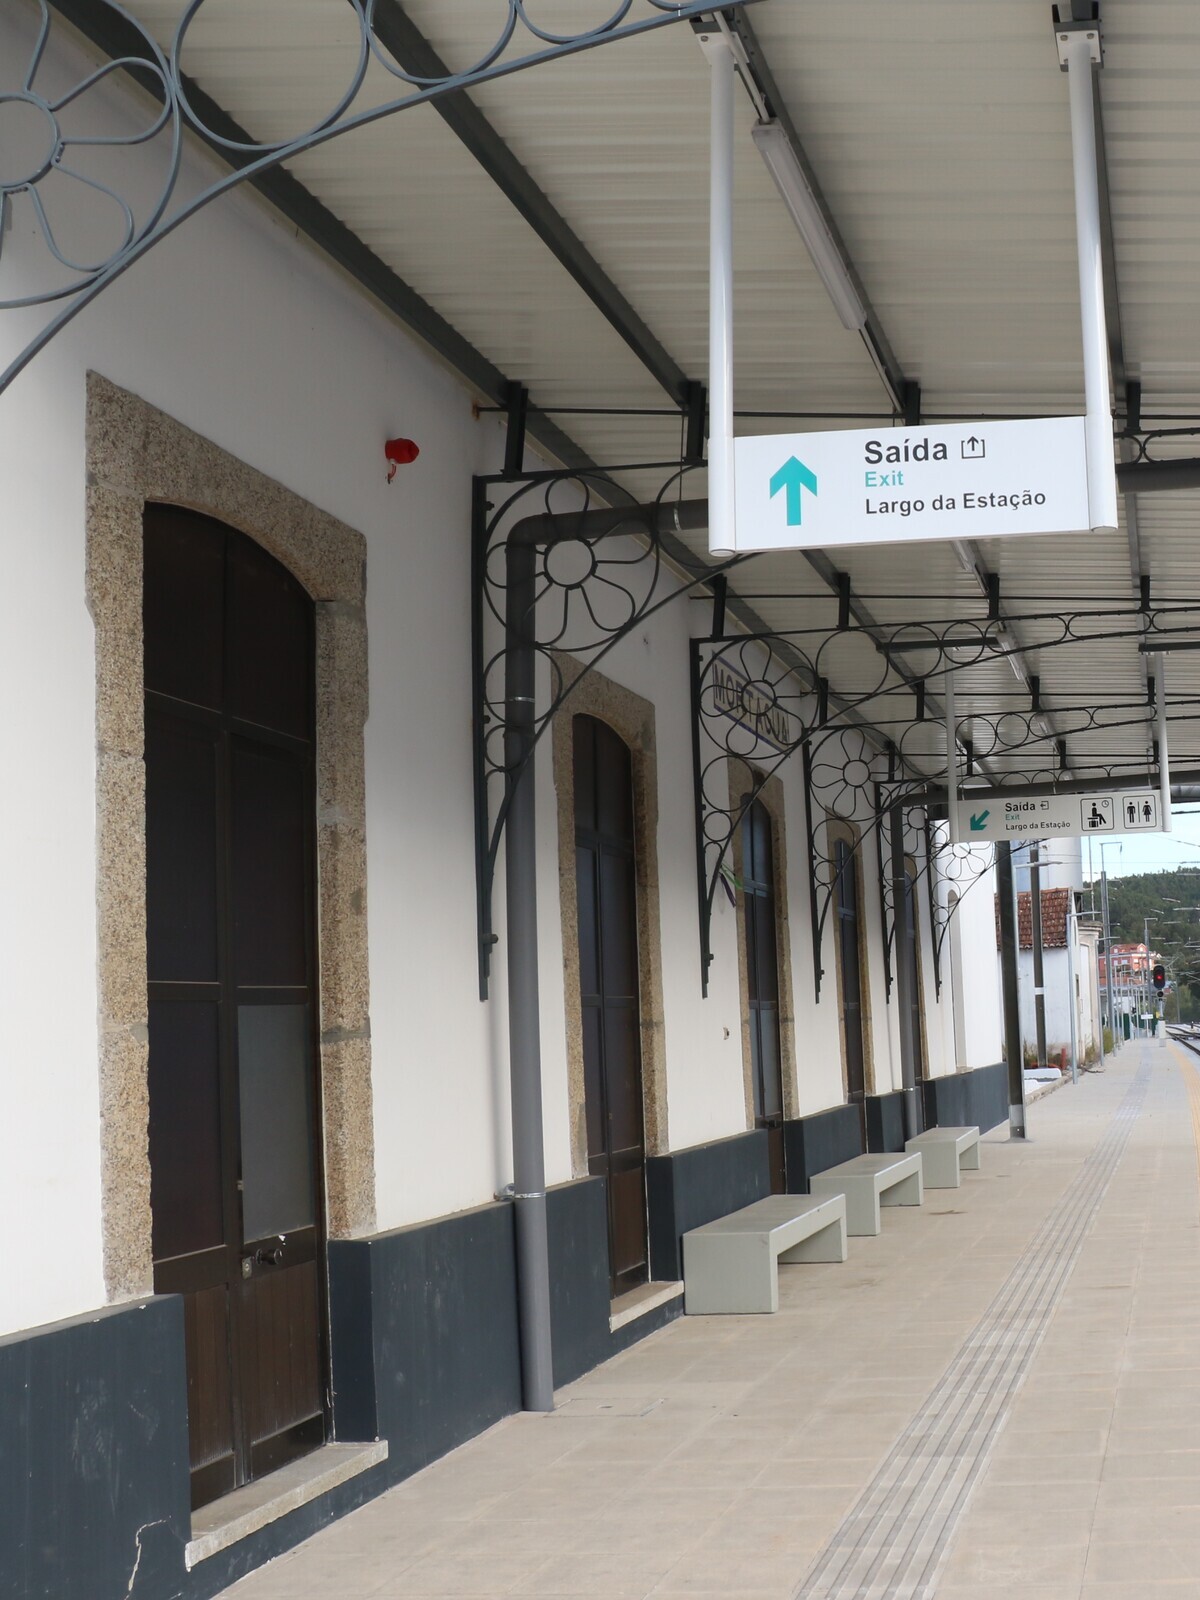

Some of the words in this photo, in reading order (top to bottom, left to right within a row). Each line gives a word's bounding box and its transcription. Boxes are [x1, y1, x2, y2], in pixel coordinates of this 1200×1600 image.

[864, 437, 948, 465] Saída
[864, 470, 904, 488] Exit
[865, 498, 925, 517] Largo
[931, 494, 956, 511] da
[963, 489, 1047, 511] Estação
[1005, 802, 1035, 811] Saída
